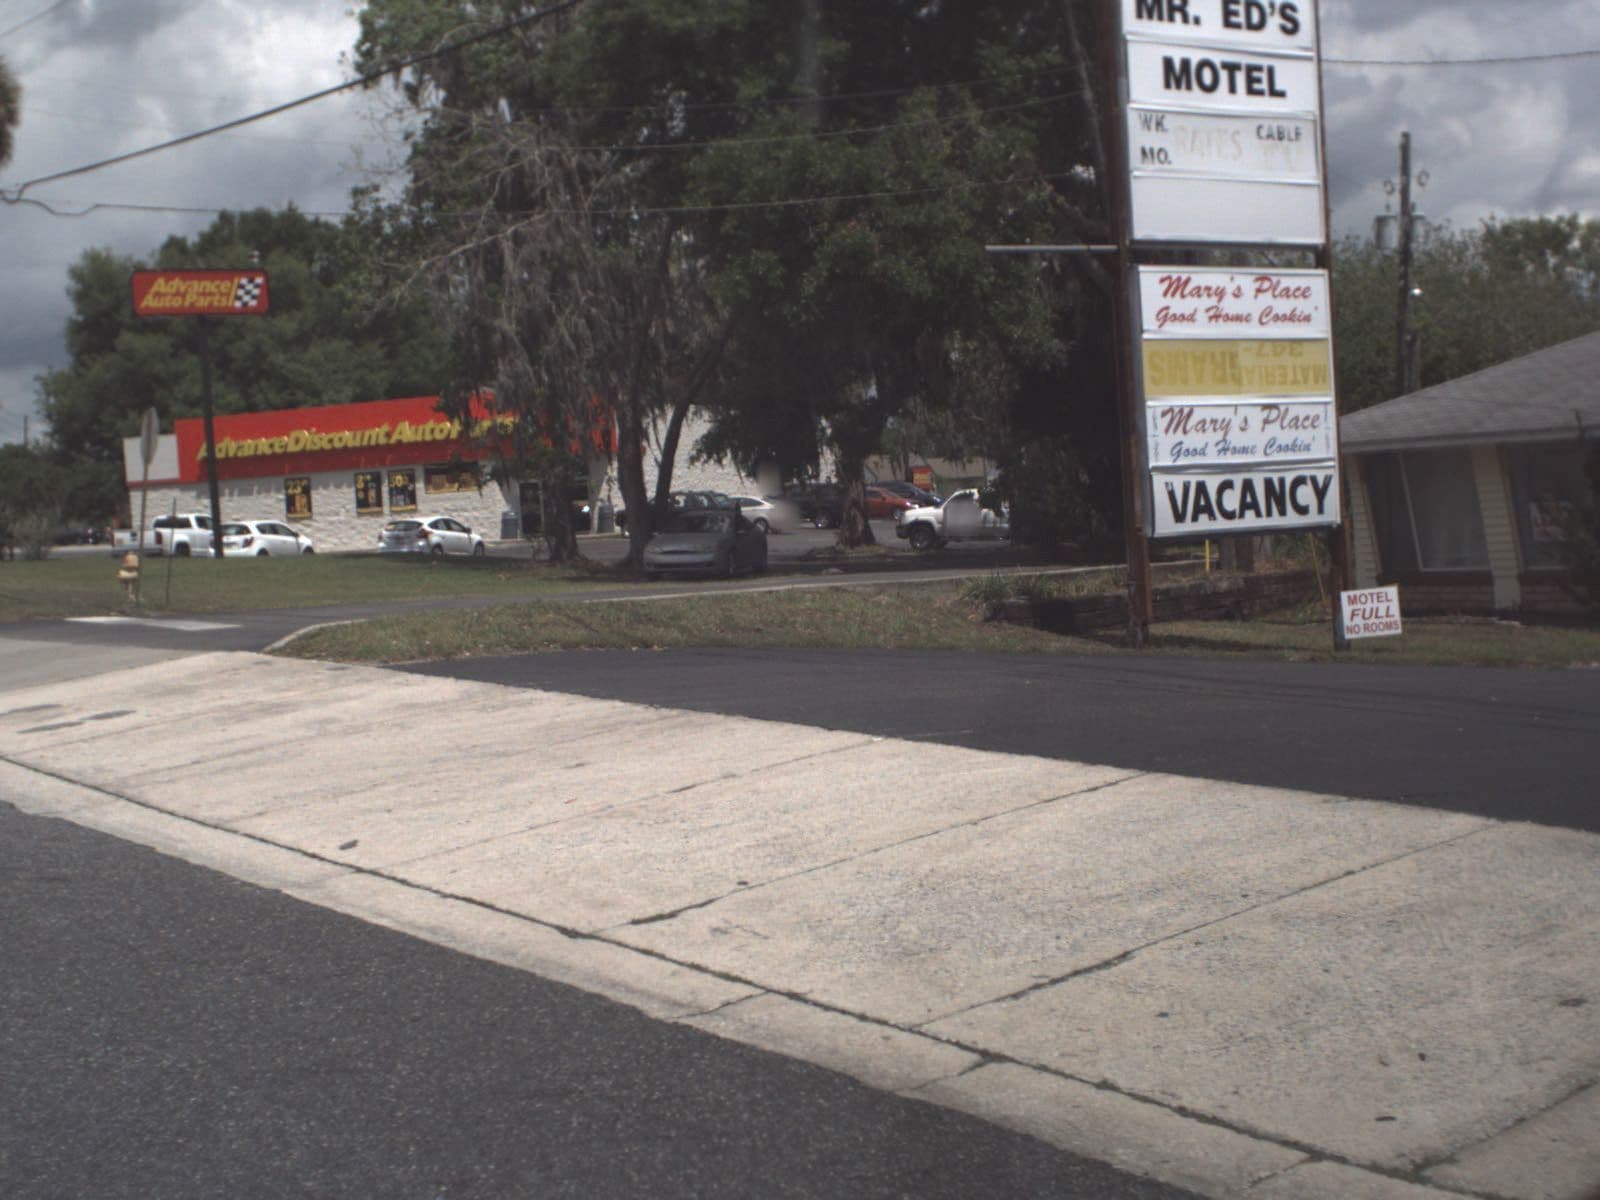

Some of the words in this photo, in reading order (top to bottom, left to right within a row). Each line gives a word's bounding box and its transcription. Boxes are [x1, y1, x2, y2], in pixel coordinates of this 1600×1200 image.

[1222, 0, 1300, 36] ED'S
[1162, 55, 1287, 98] MOTEL
[149, 277, 232, 295] Advance
[1158, 274, 1243, 305] Mary's
[1253, 275, 1312, 299] Place
[140, 293, 183, 309] Auto
[183, 292, 230, 309] Parts
[1155, 305, 1198, 329] Good
[1203, 304, 1252, 324] Home
[1160, 404, 1249, 440] Mary's
[1260, 403, 1321, 432] Place
[287, 426, 392, 452] Discount
[1169, 440, 1209, 463] Good
[1213, 438, 1257, 457] Home
[1164, 474, 1334, 524] VACANCY
[1346, 591, 1393, 606] MOTEL
[1350, 606, 1395, 622] FULL
[1346, 623, 1361, 635] NO
[1363, 620, 1400, 633] ROOMS
